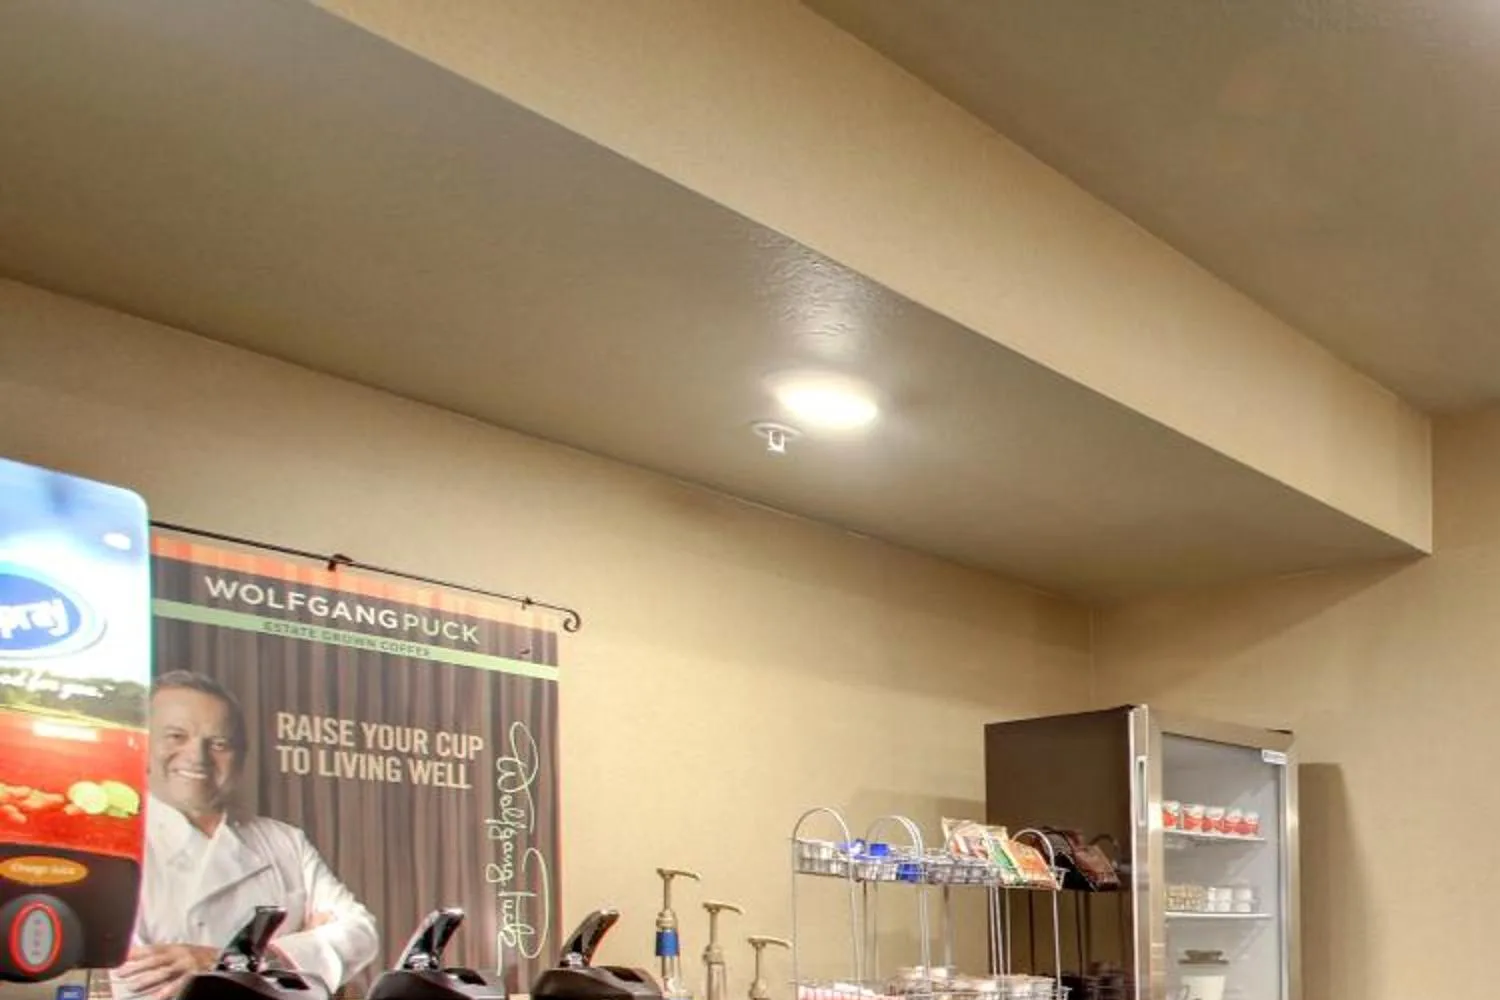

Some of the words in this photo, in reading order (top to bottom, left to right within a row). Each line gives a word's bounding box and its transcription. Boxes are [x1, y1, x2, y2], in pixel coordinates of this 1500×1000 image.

[204, 575, 398, 629] WOLFGANG
[402, 612, 481, 645] PUCK
[276, 711, 355, 747] RAISE
[361, 721, 429, 755] YOUR
[436, 731, 484, 760] CUP
[275, 745, 311, 775] TO
[318, 749, 401, 783] LIVING
[407, 757, 473, 789] WELL
